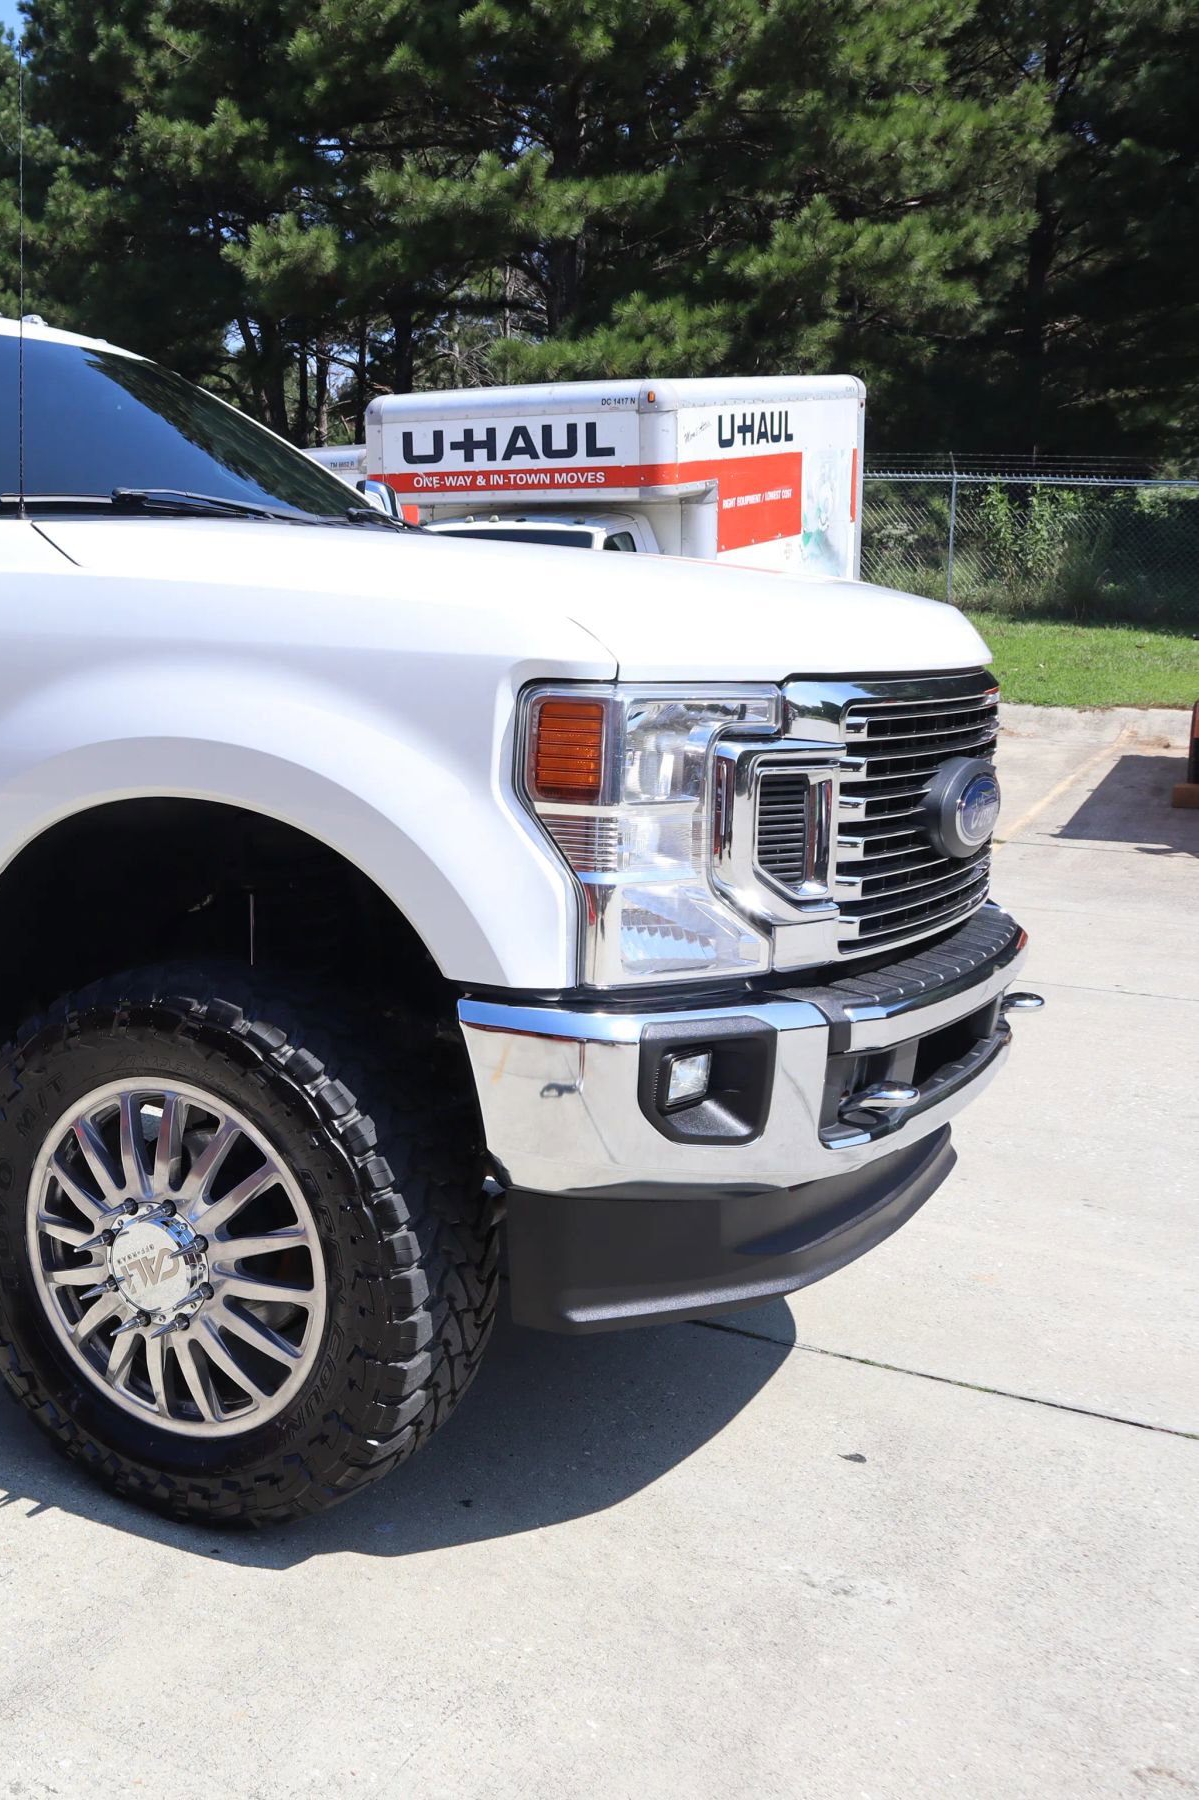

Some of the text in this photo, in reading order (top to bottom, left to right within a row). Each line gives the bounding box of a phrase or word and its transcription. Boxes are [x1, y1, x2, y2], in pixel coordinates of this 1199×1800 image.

[601, 397, 636, 406] DC 1417 N
[402, 421, 616, 465] U-HAUL
[718, 410, 794, 449] U-HAUL
[413, 471, 606, 489] ONE-WAY & IN-TOWN MOVES
